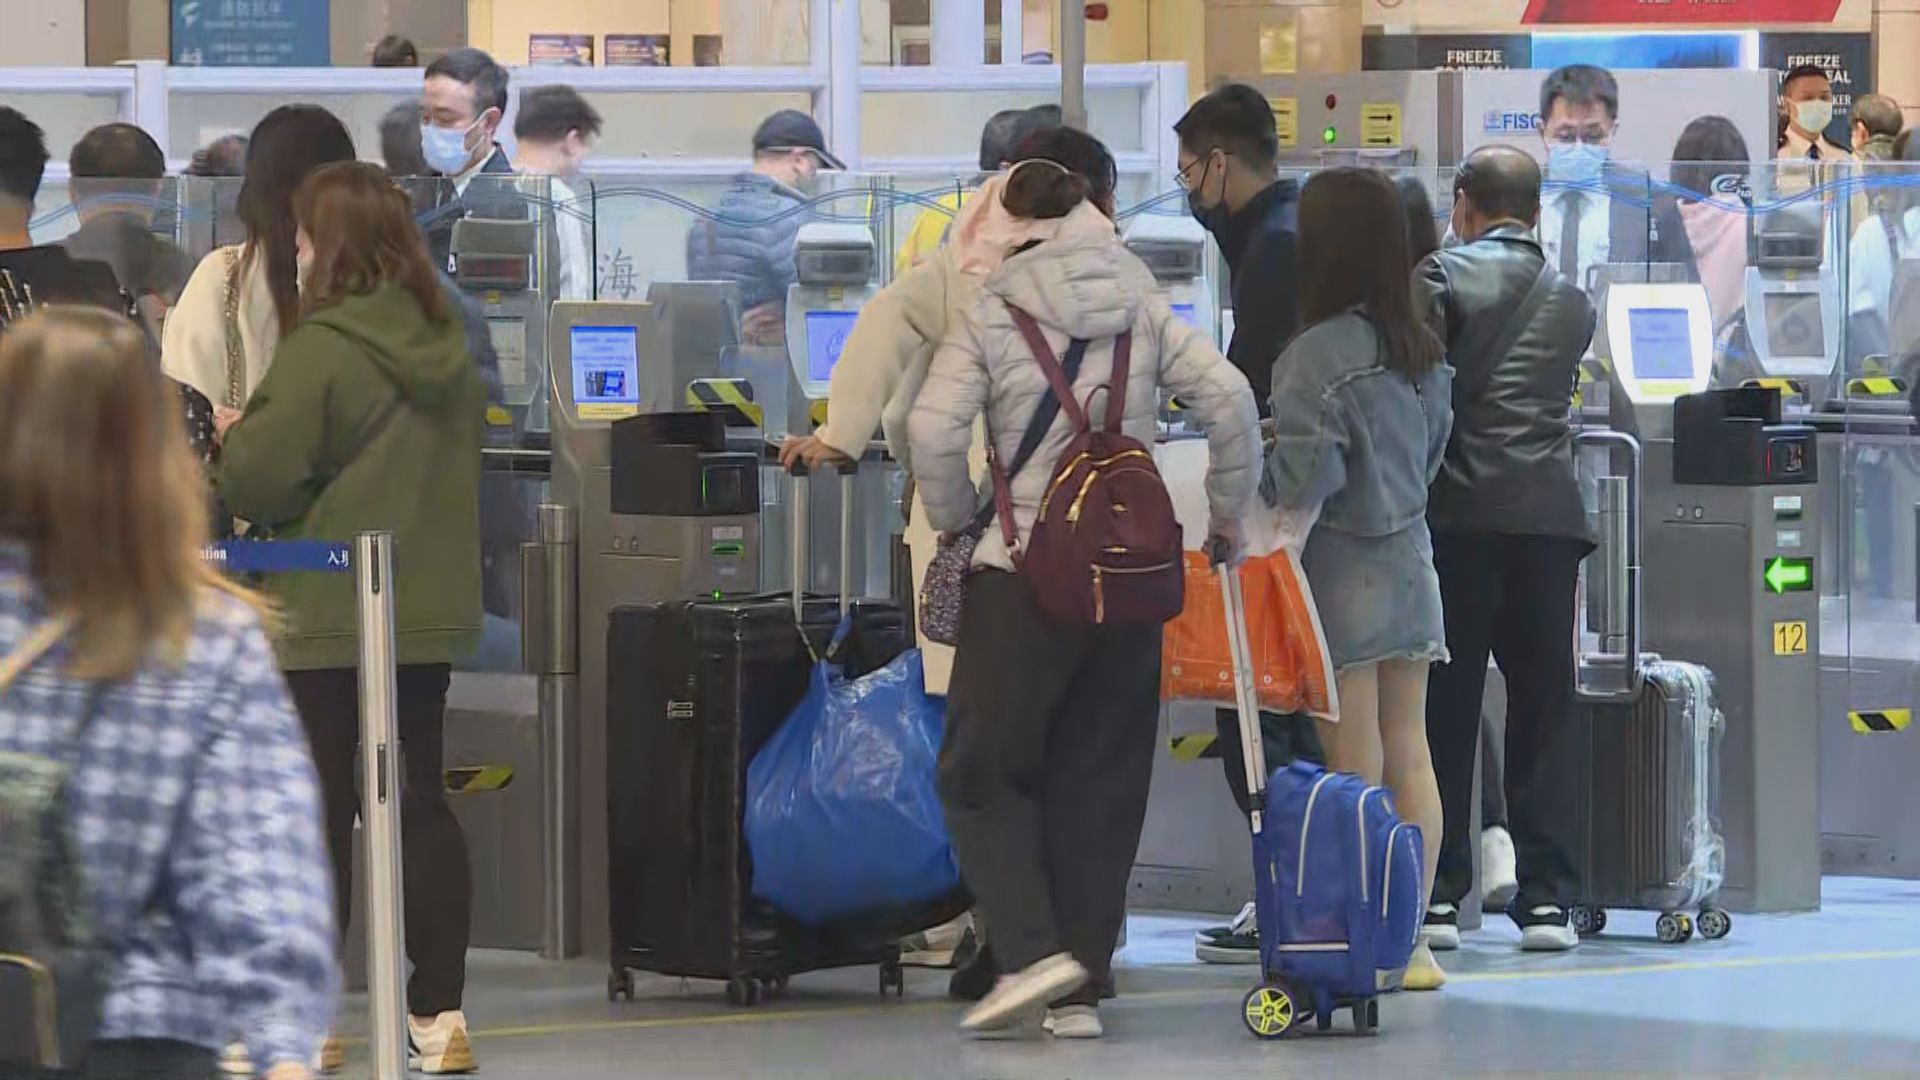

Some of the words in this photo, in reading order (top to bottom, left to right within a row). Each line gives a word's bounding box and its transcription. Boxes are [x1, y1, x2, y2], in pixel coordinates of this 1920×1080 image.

[1446, 50, 1502, 64] FREEZE
[1787, 54, 1841, 69] FREEZE
[599, 247, 639, 299] 海
[1779, 624, 1804, 653] 12
